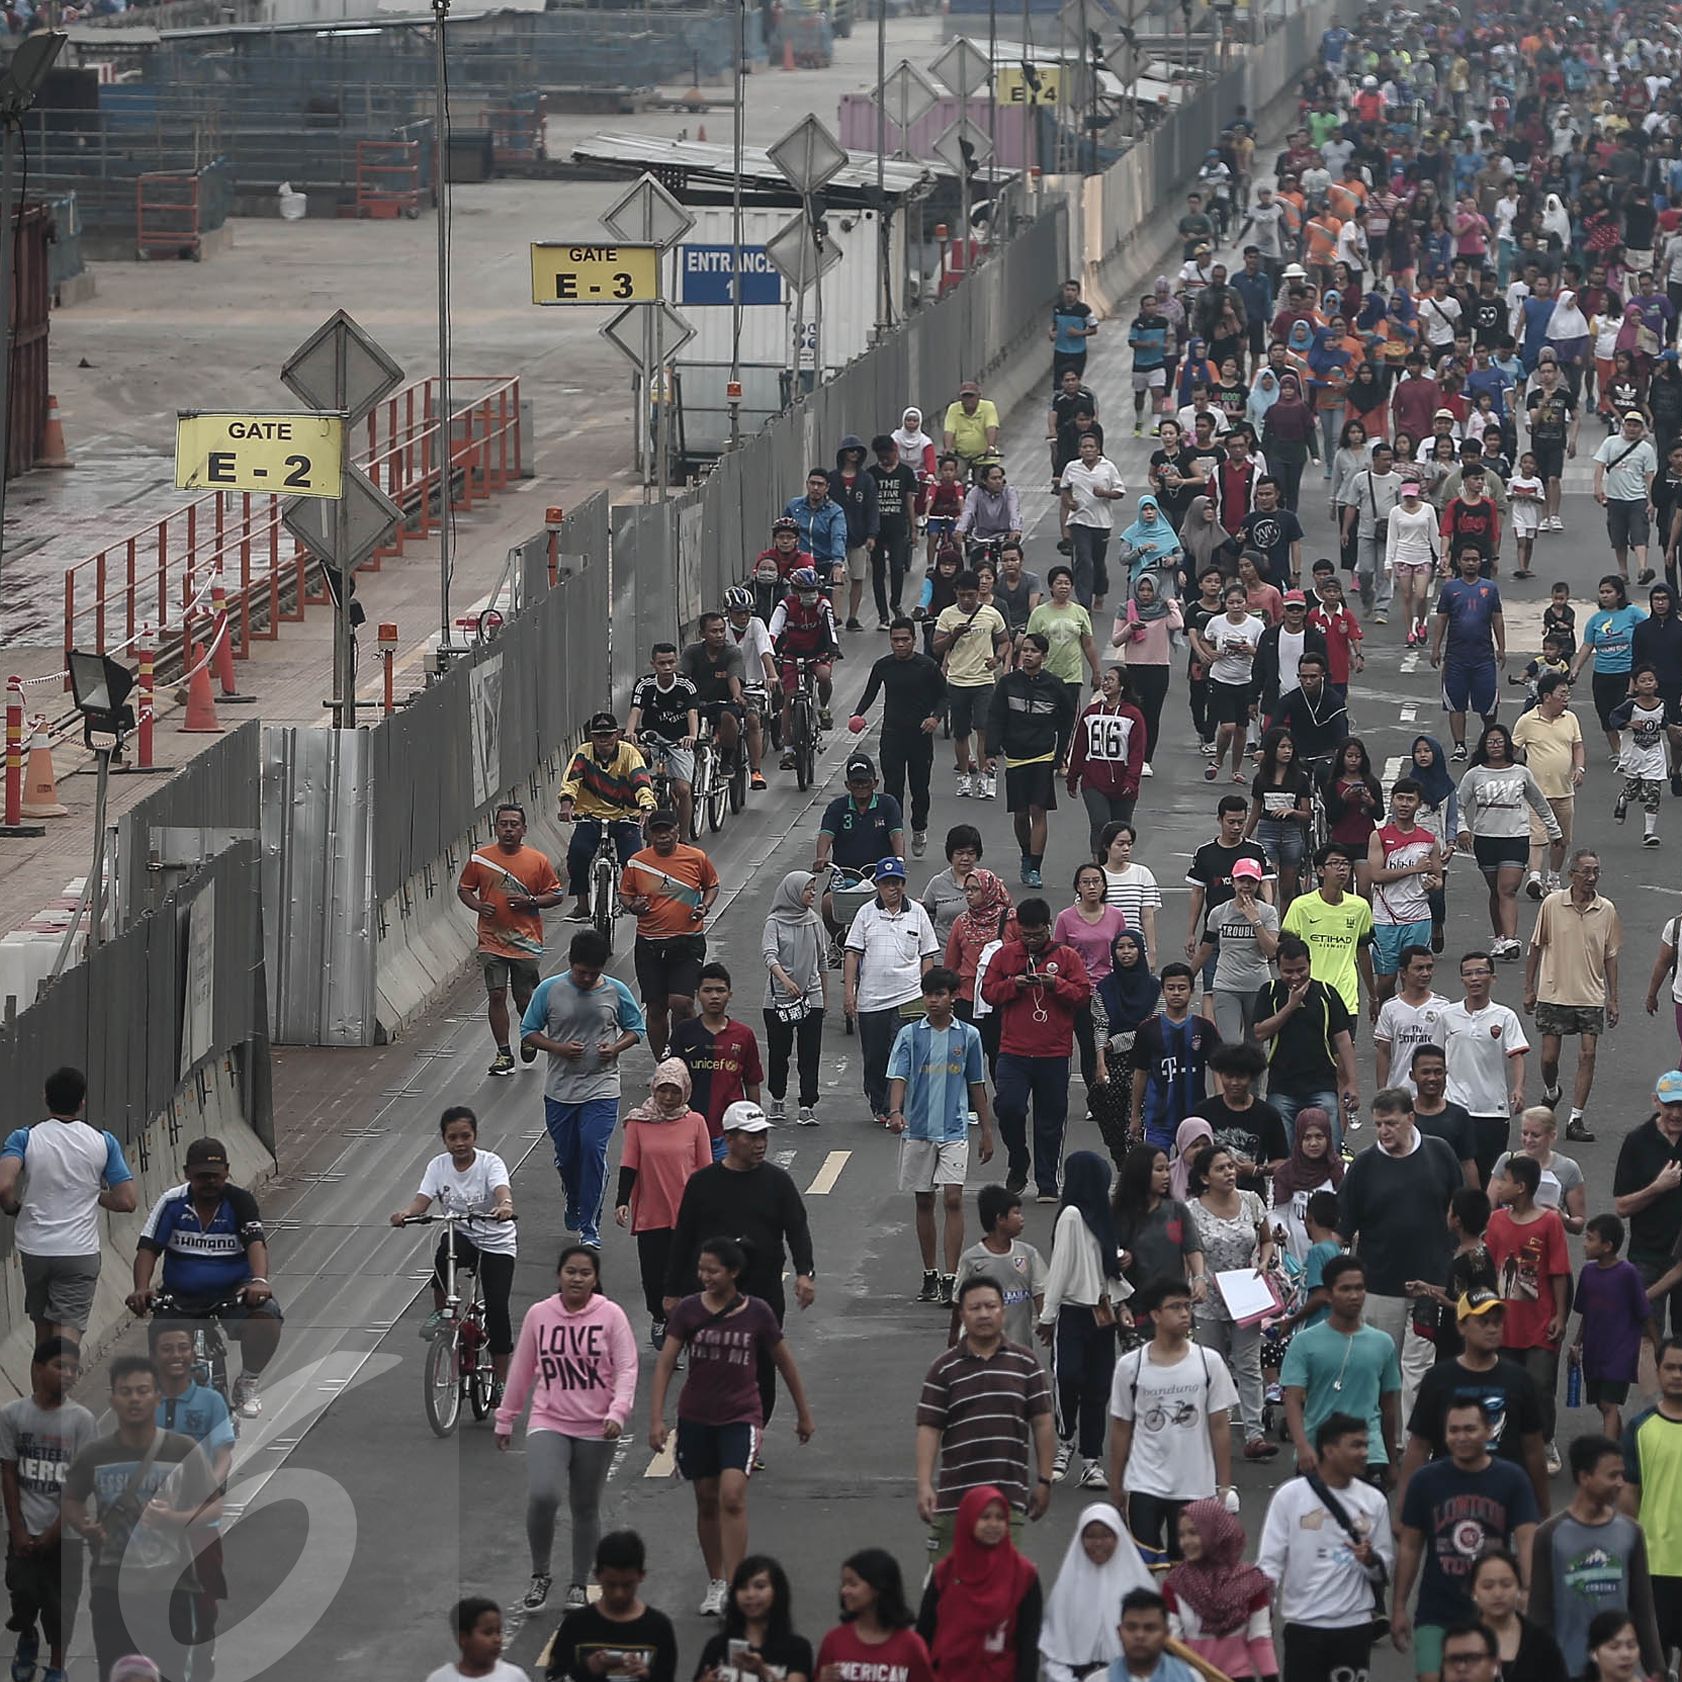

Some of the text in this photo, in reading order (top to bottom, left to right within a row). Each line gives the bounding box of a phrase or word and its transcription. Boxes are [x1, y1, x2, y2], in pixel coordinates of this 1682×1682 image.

[1044, 86, 1057, 101] 4
[570, 248, 618, 263] GATE
[556, 273, 578, 298] E
[613, 273, 634, 299] 3
[228, 422, 292, 441] GATE
[208, 451, 237, 483] E
[283, 455, 312, 488] 2
[878, 479, 900, 489] THE
[843, 813, 853, 829] 3
[1310, 933, 1352, 945] ETIHAD
[1412, 1024, 1423, 1034] Fly
[690, 1057, 725, 1071] unicef
[175, 1235, 236, 1250] SHIMANO
[539, 1324, 604, 1358] LOVE
[540, 1357, 608, 1391] PINK
